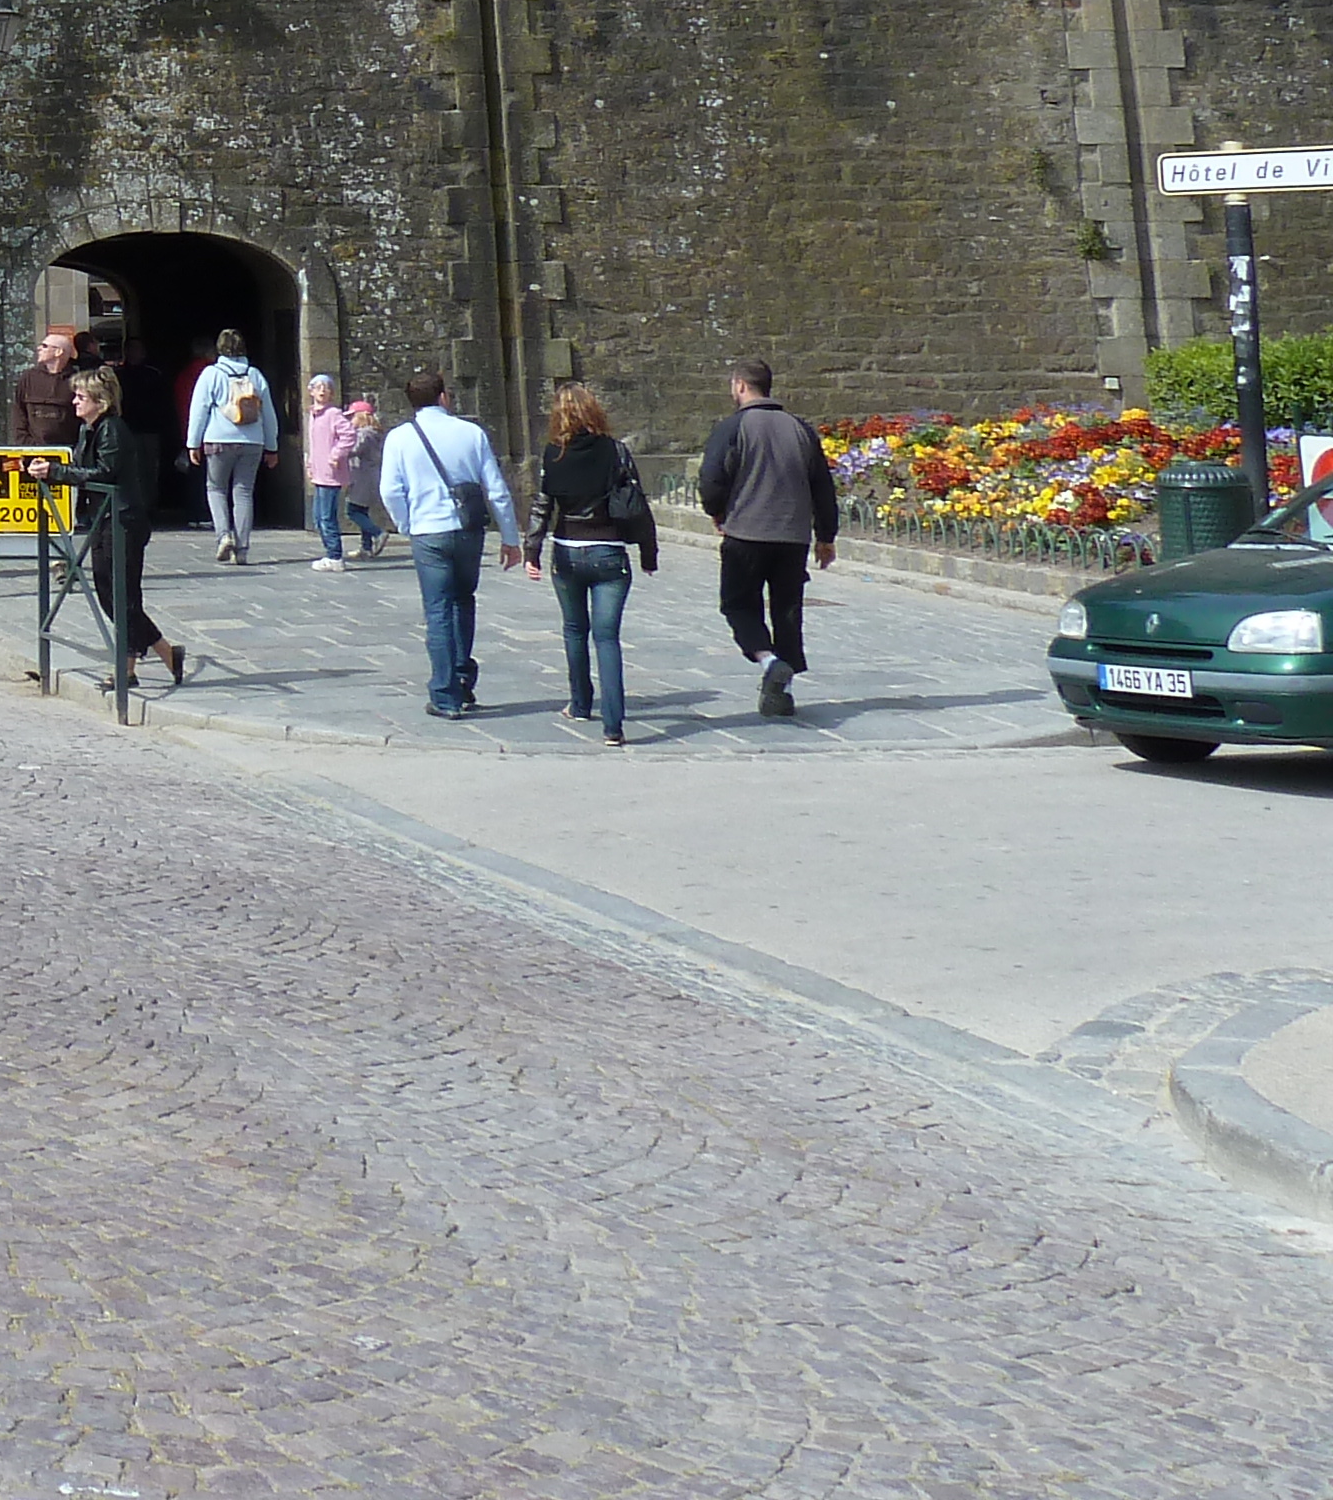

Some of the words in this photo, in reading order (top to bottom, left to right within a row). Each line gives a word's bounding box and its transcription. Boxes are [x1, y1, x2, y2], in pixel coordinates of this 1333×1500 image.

[1171, 162, 1237, 183] Hôtel
[1256, 161, 1284, 179] de
[0, 507, 38, 522] 200
[1109, 667, 1141, 689] 1466
[1144, 671, 1163, 692] YA
[1166, 673, 1186, 693] 35
